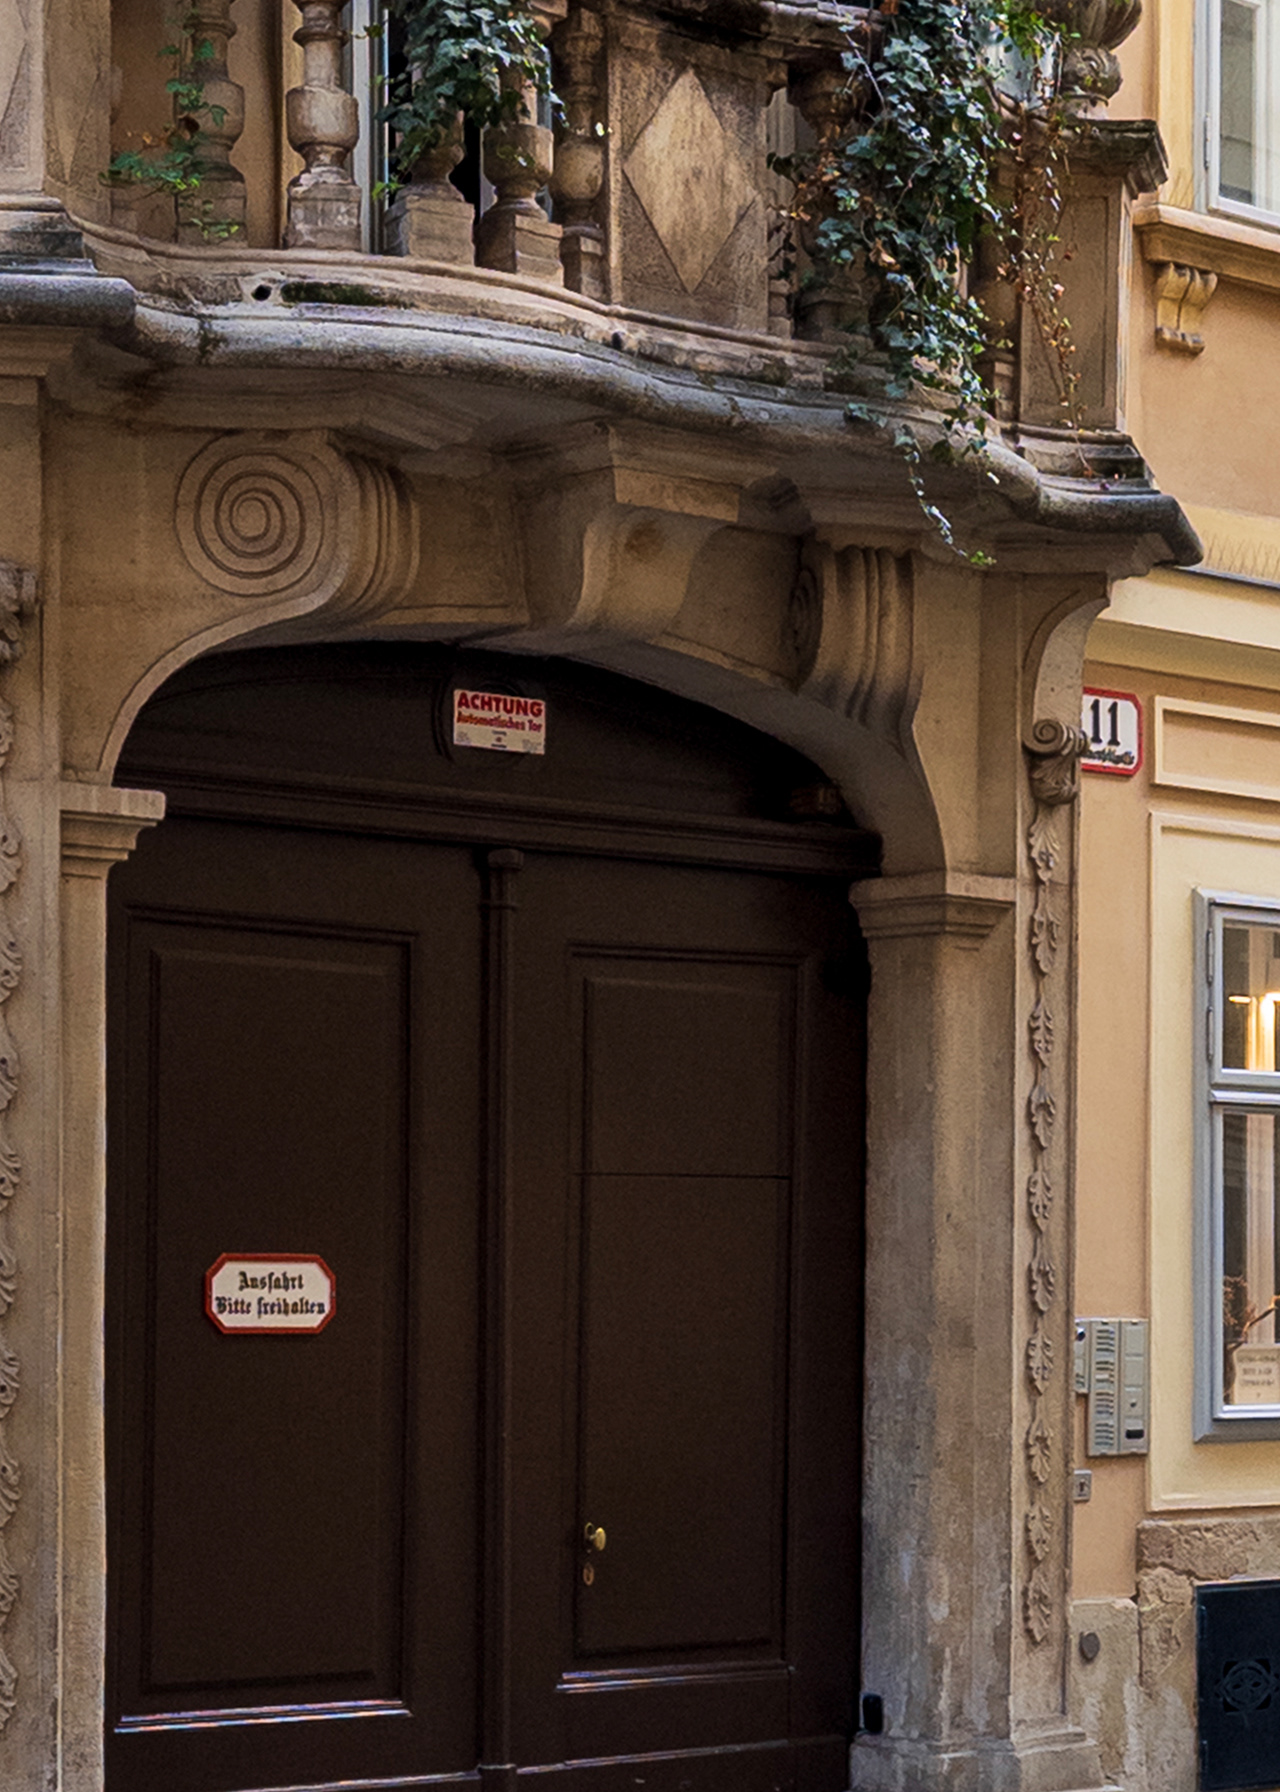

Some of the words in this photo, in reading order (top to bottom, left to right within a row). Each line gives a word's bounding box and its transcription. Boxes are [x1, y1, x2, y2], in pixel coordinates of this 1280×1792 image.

[457, 692, 543, 718] ACHTUNG
[456, 711, 526, 731] Automatisches
[527, 719, 543, 733] Tor
[1090, 698, 1121, 746] 11
[238, 1271, 304, 1293] Ausfahrt
[215, 1296, 252, 1315] Bitte
[257, 1296, 326, 1319] freihalten
